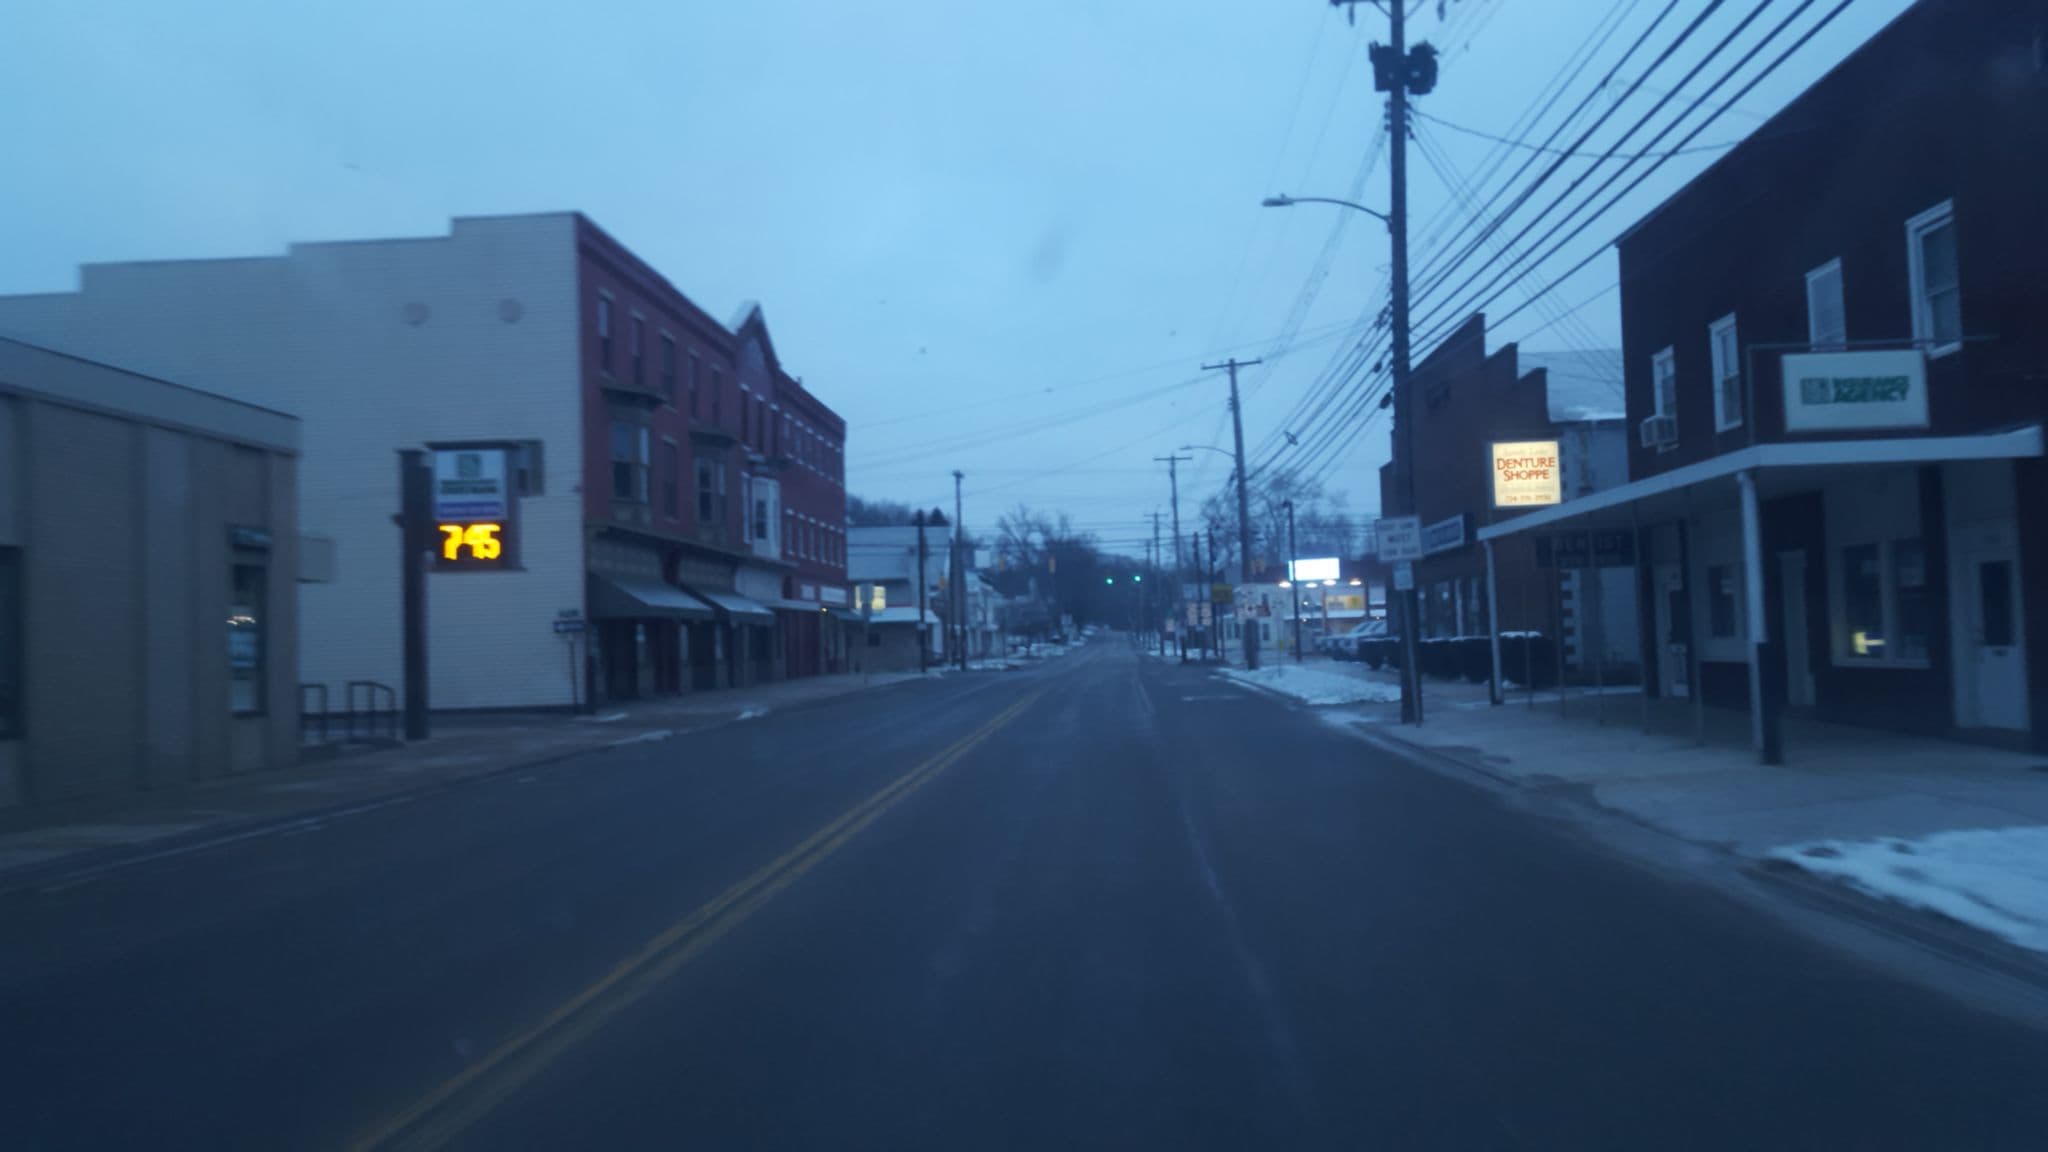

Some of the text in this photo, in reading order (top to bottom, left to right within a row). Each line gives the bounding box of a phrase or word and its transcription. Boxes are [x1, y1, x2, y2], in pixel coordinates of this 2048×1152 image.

[1833, 386, 1909, 403] AGENCY
[1496, 457, 1557, 470] DENTURE
[1503, 469, 1551, 482] SHOPPE
